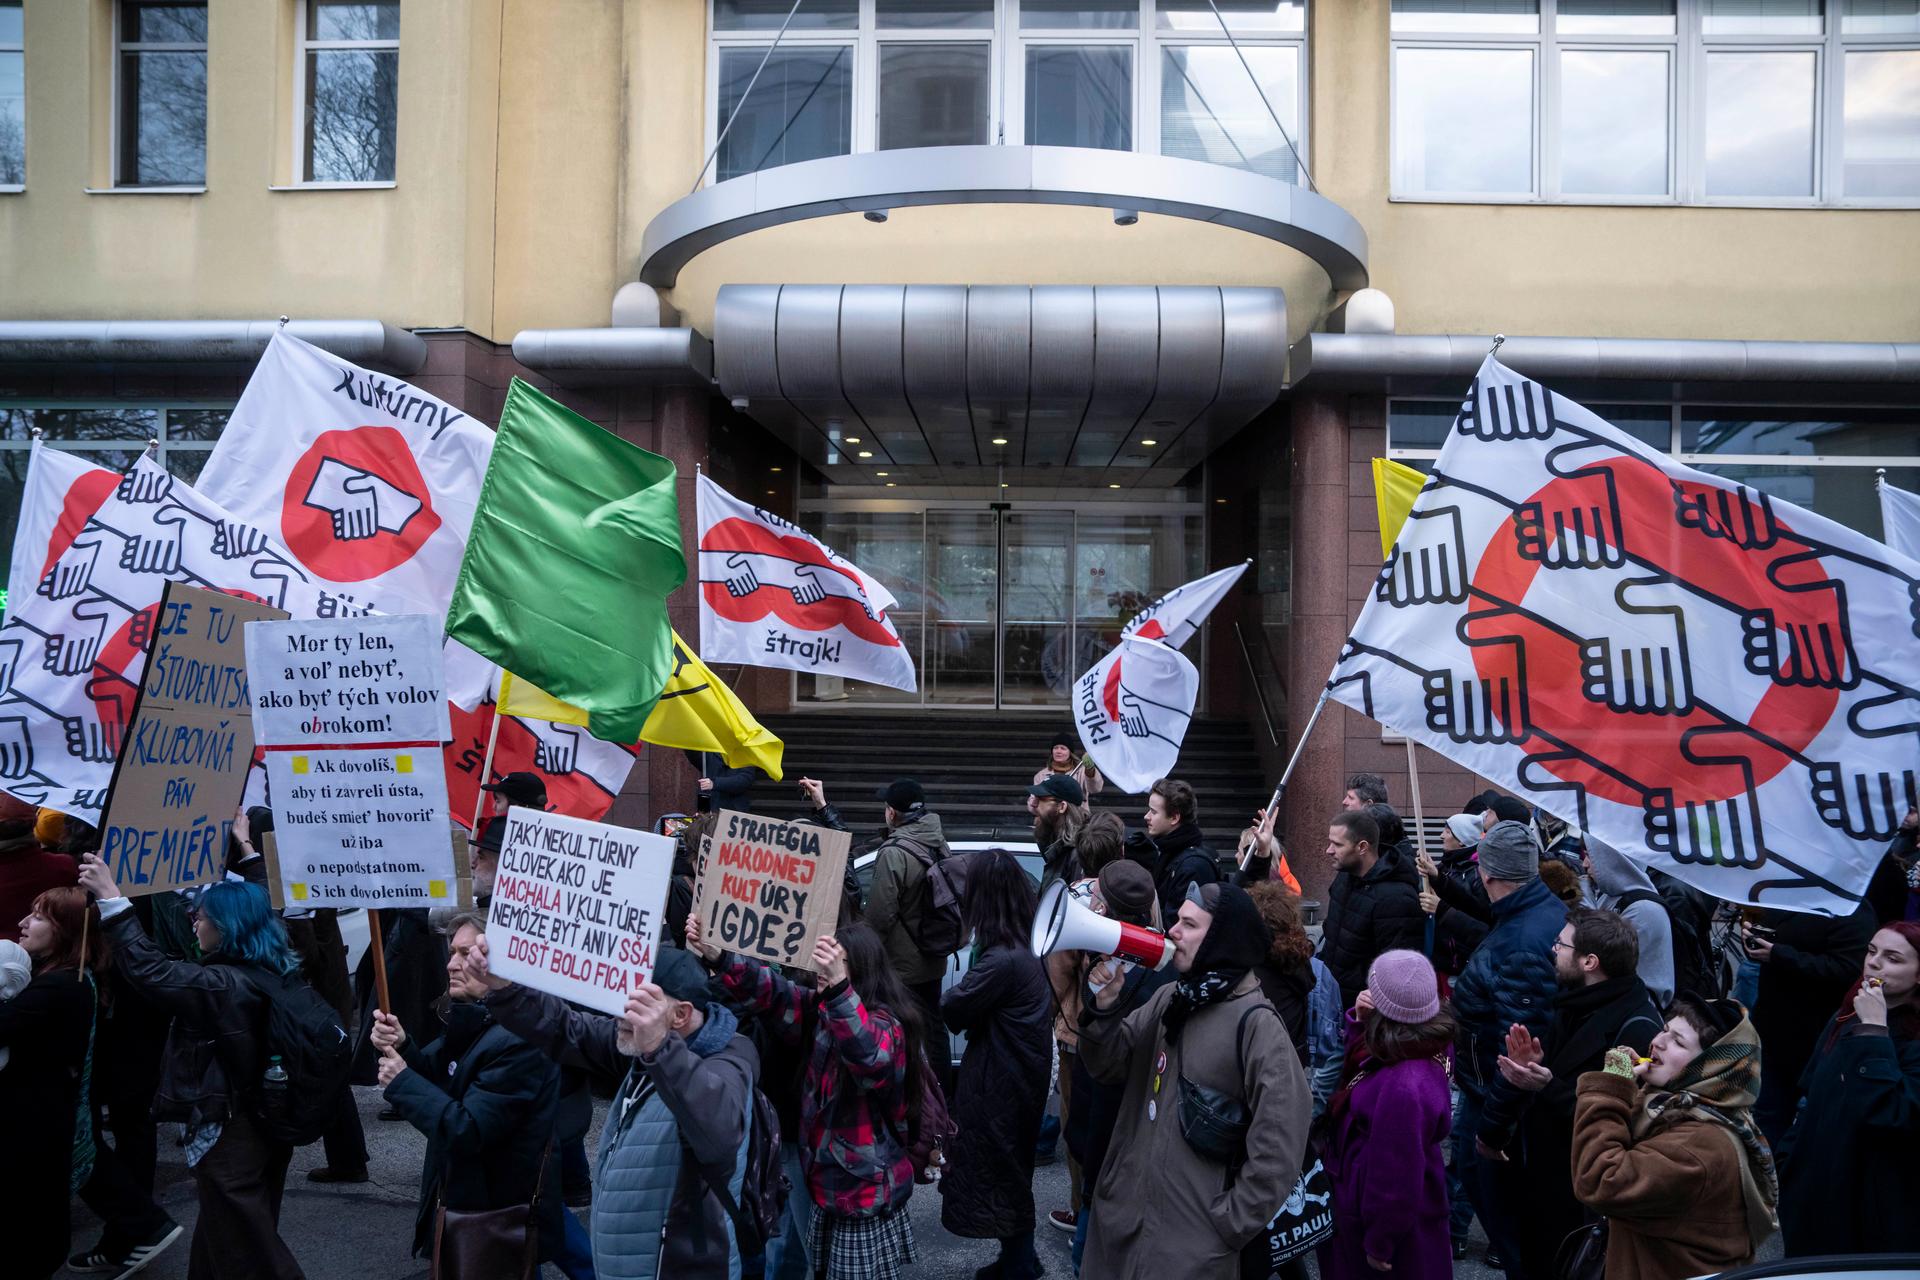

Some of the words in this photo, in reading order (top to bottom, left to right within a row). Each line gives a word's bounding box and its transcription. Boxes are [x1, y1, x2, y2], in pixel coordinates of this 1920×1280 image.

[160, 602, 192, 635] JE
[207, 606, 235, 643] TU
[287, 634, 328, 653] Mor
[334, 635, 352, 655] ty
[359, 632, 394, 651] len,
[765, 629, 841, 665] štrajk!
[148, 643, 252, 708] ŠTUDENTSK
[284, 668, 294, 680] a
[259, 690, 293, 708] ako
[298, 688, 332, 711] byť
[337, 687, 381, 710] tých
[385, 686, 440, 704] volov
[1079, 668, 1111, 745] štrajk!
[301, 714, 392, 734] obrokom!
[130, 718, 235, 773] KLUBOVŇA
[314, 759, 335, 773] Ak
[339, 757, 394, 774] dovolíš,
[162, 776, 196, 809] PÁN
[291, 785, 317, 802] aby
[321, 785, 331, 798] ti
[335, 784, 384, 799] zavreli
[388, 783, 424, 798] ústa,
[286, 811, 328, 824] budeš
[331, 810, 372, 824] smieť
[376, 808, 434, 823] hovoriť
[727, 815, 821, 857] STRATÉGIA
[509, 818, 543, 848] TAKÝ
[541, 827, 640, 870] NEKULTÚRNY
[718, 841, 817, 885] NÁRODNEJ
[307, 863, 316, 874] o
[320, 861, 425, 877] nepodstatnom.
[502, 841, 559, 882] ČLOVEK
[555, 861, 586, 888] AKO
[591, 869, 616, 896] JE
[311, 885, 321, 898] S
[324, 884, 346, 898] ich
[350, 884, 428, 900] dovolením.
[496, 874, 561, 914] MACHALA
[566, 891, 577, 916] V
[576, 894, 652, 941] KULTÚRE,
[720, 870, 808, 920] KULTÚRY
[492, 900, 550, 940] NEMÔŽE
[550, 917, 582, 948] BYŤ
[581, 927, 605, 956] ANI
[606, 934, 619, 959] V
[507, 935, 549, 969] DOSŤ
[550, 948, 592, 982] BOLO
[1269, 1231, 1293, 1250] ST.
[1292, 1208, 1332, 1242] PAULI
[1272, 1252, 1293, 1263] MORE
